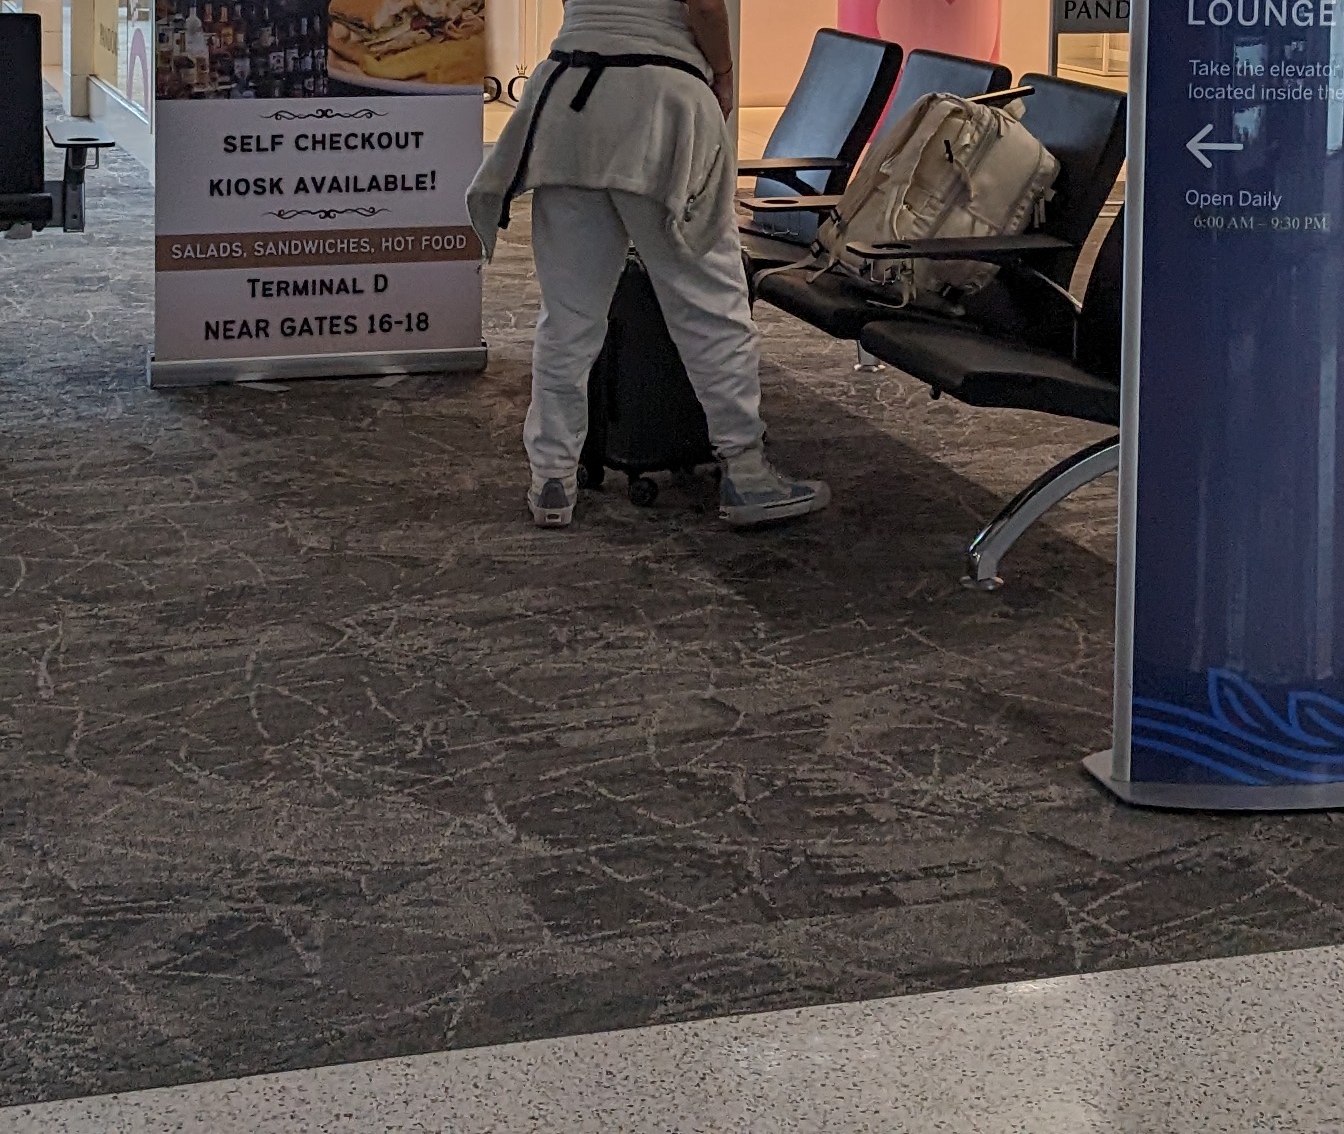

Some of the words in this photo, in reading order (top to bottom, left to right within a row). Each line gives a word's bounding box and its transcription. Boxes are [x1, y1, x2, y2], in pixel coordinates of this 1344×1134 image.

[1188, 59, 1231, 77] Take
[1235, 59, 1265, 77] the
[1269, 59, 1341, 77] elevator
[1188, 82, 1256, 100] located
[1260, 83, 1314, 101] inside
[222, 133, 285, 154] SELF
[293, 130, 425, 152] CHECKOUT
[208, 175, 285, 197] KIOSK
[293, 169, 438, 195] AVAILABLE!
[1184, 189, 1234, 210] Open
[1238, 189, 1283, 211] Daily
[1193, 215, 1225, 230] 6:00
[1225, 215, 1255, 230] AM
[1270, 216, 1301, 230] 9:30
[1303, 216, 1327, 230] PM
[171, 241, 247, 260] SALADS,
[253, 237, 376, 257] SANDWICHES,
[380, 235, 416, 253] HOT
[421, 233, 468, 251] FOOD
[246, 276, 364, 298] TERMINAL
[373, 273, 389, 294] D
[203, 317, 271, 341] NEAR
[279, 314, 358, 338] GATES
[367, 311, 430, 335] 16-18
